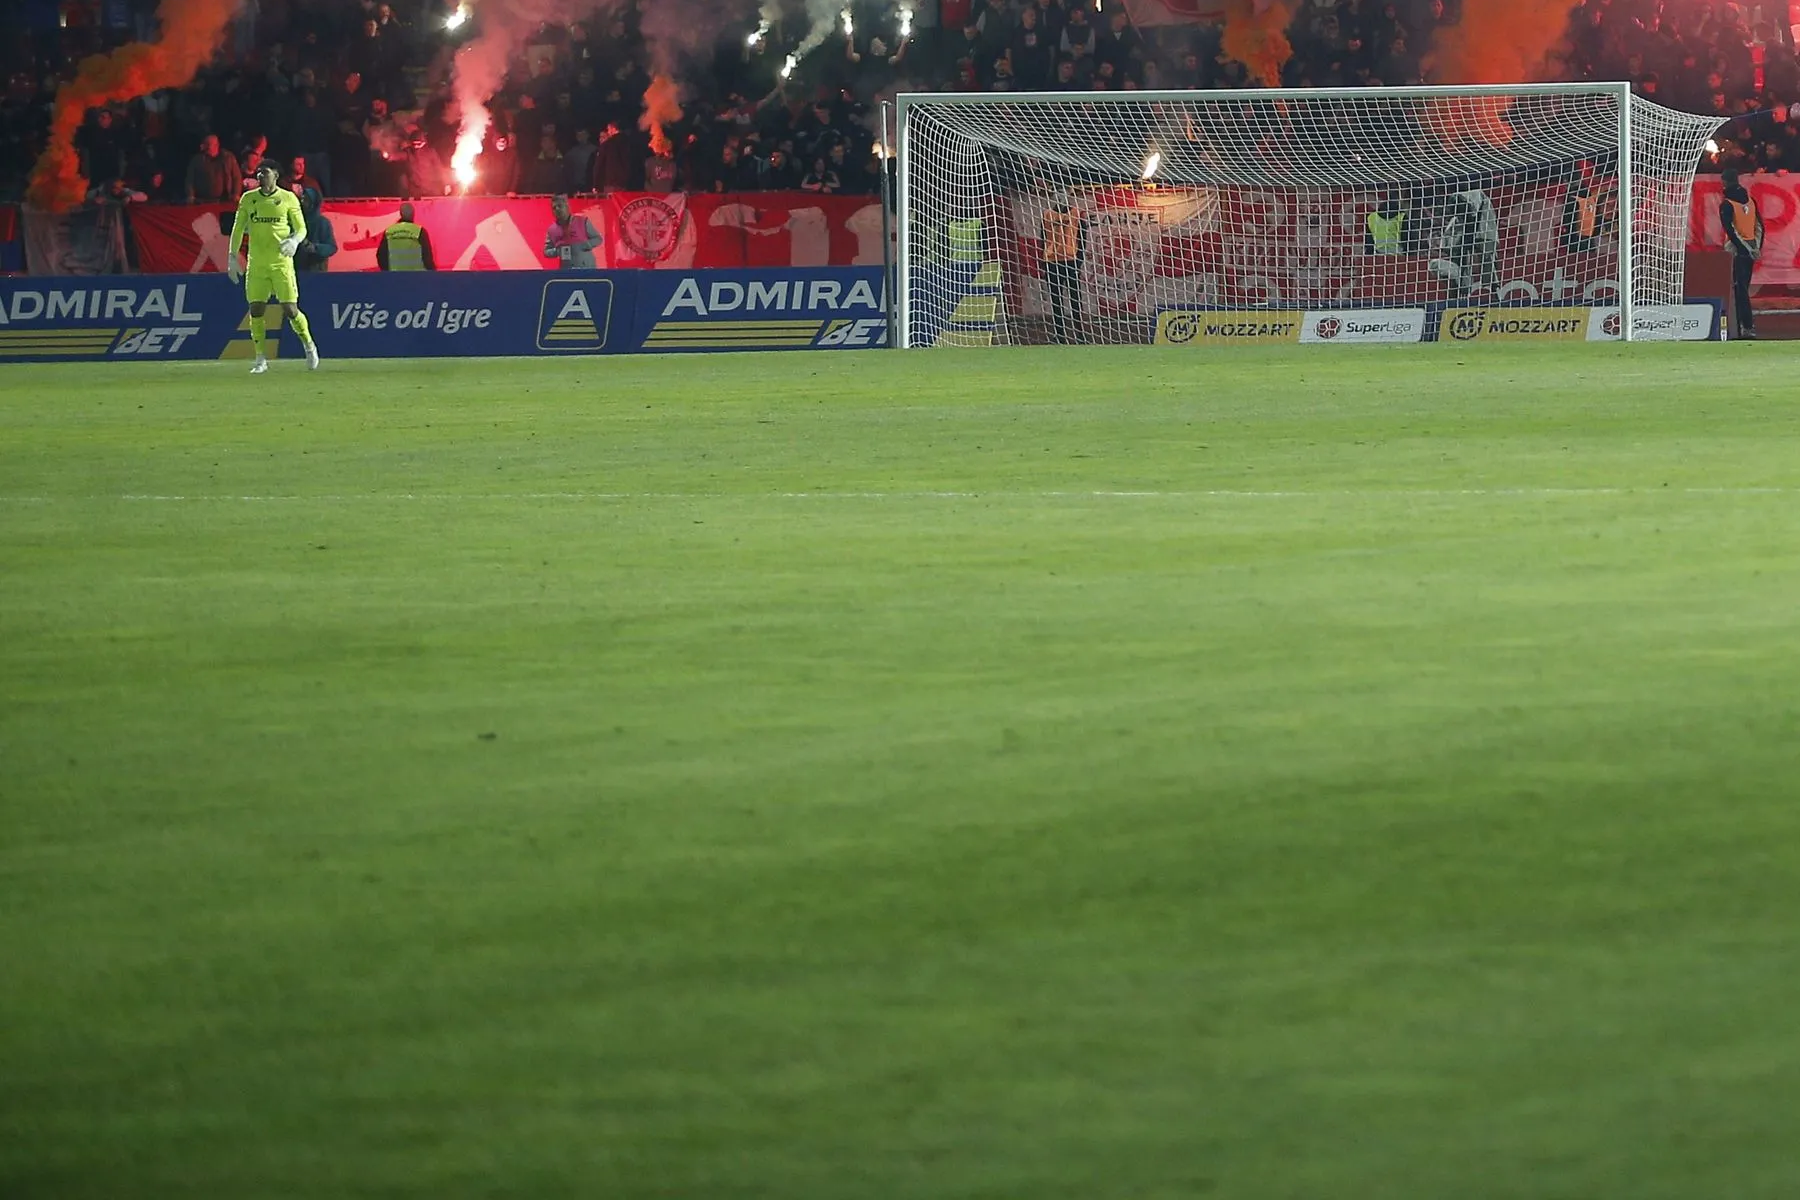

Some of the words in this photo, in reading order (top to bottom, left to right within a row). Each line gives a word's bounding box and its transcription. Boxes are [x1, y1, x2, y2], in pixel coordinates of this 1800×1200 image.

[661, 276, 888, 317] ADMIRA
[331, 303, 389, 329] Više
[395, 302, 433, 328] od
[437, 302, 491, 333] igre
[1346, 321, 1412, 335] SuperLiga
[1488, 319, 1580, 334] MOZZART
[113, 327, 201, 354] BET
[1203, 323, 1295, 337] MOZZART
